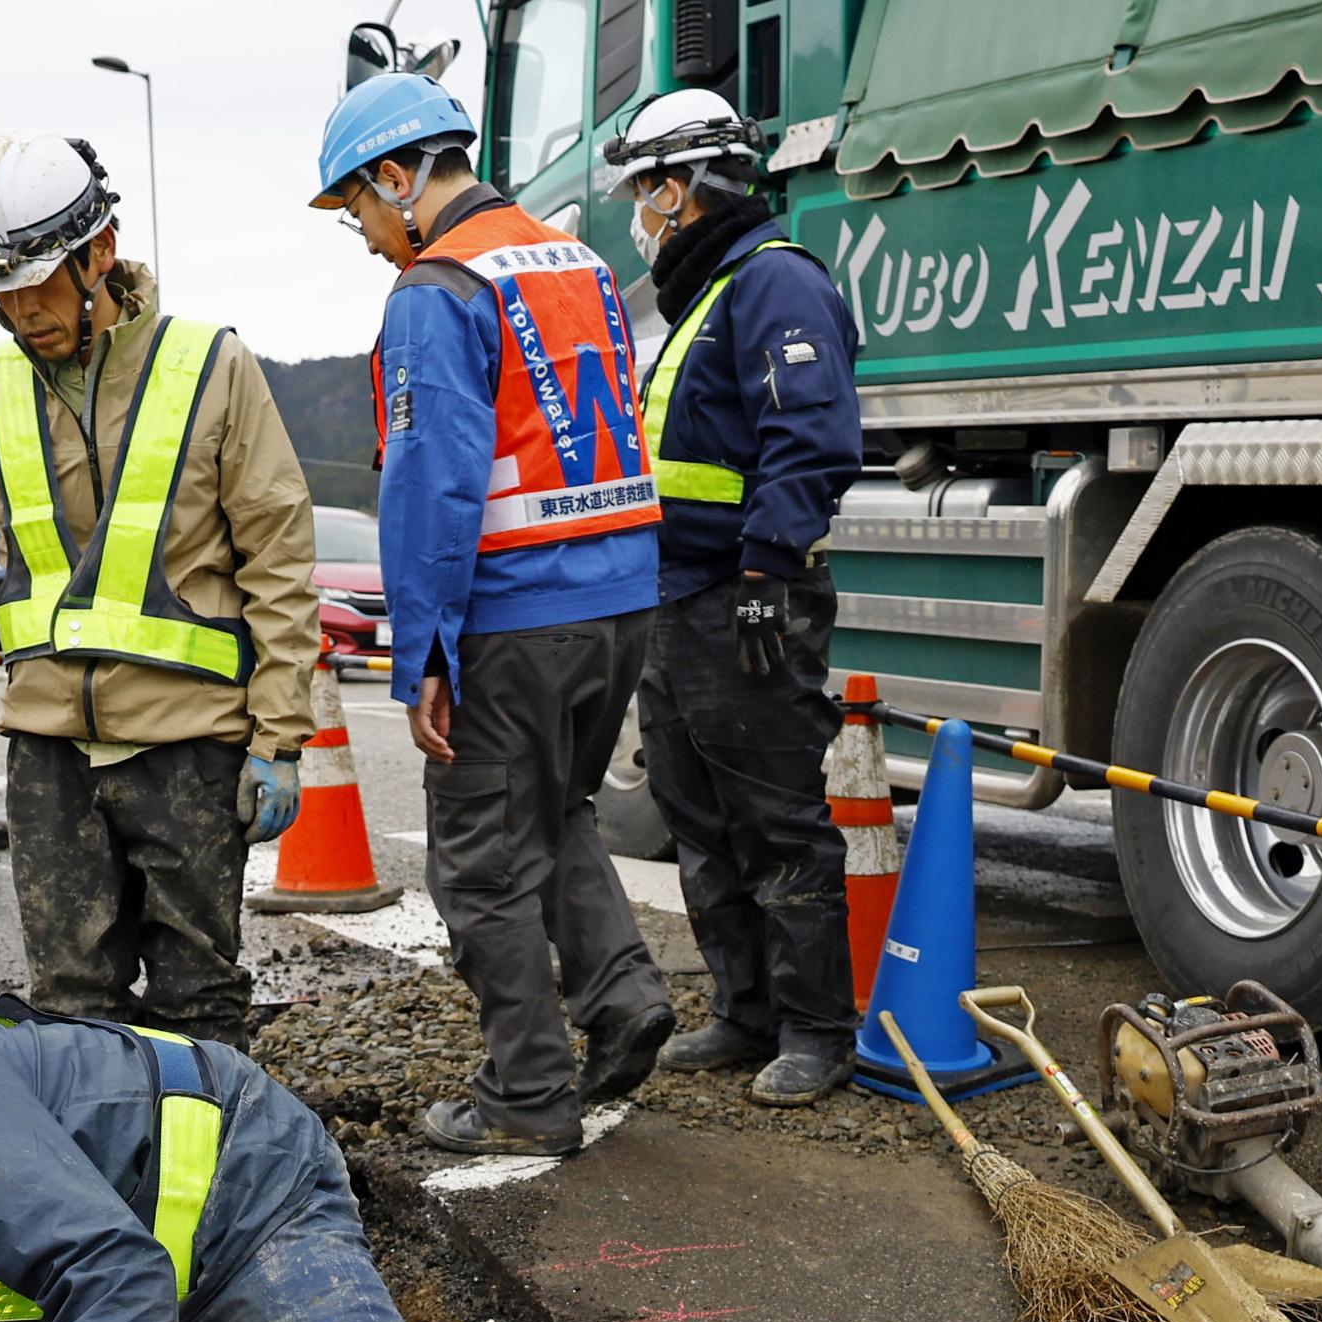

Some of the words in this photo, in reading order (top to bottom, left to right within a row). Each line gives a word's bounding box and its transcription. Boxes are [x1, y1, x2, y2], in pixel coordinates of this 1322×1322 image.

[356, 119, 421, 156] 東京都水道局
[491, 246, 594, 270] 東京都水道局
[835, 213, 989, 345] KUBO
[1004, 178, 1299, 331] KENZAI
[540, 480, 654, 518] 東京水道災害救援隊
